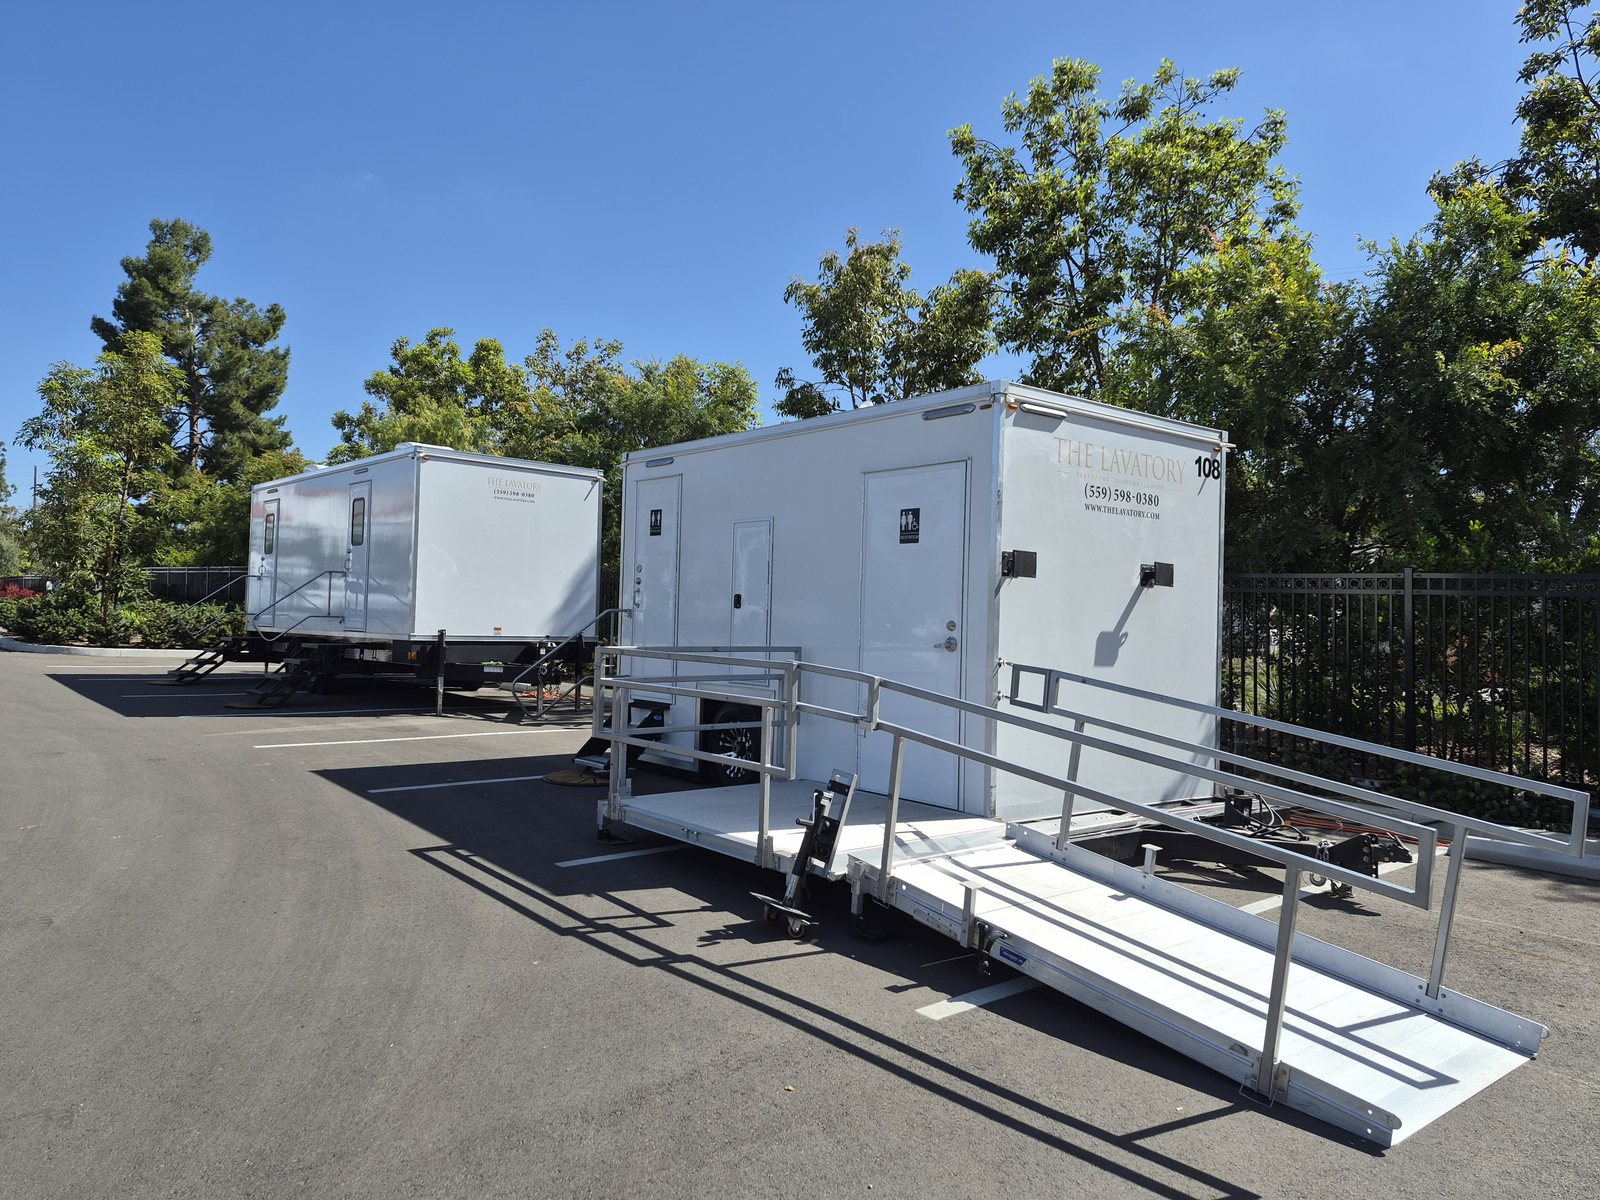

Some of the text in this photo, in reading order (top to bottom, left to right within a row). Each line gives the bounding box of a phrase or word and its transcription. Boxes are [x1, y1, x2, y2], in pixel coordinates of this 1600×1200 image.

[1054, 437, 1093, 469] THE
[1101, 445, 1187, 484] LAVATORY
[1194, 455, 1220, 480] 108
[487, 477, 541, 490] THE LAVATORY
[1084, 482, 1160, 507] (559) 598-0380
[1084, 503, 1160, 520] WWW.THELAVATORY.COM
